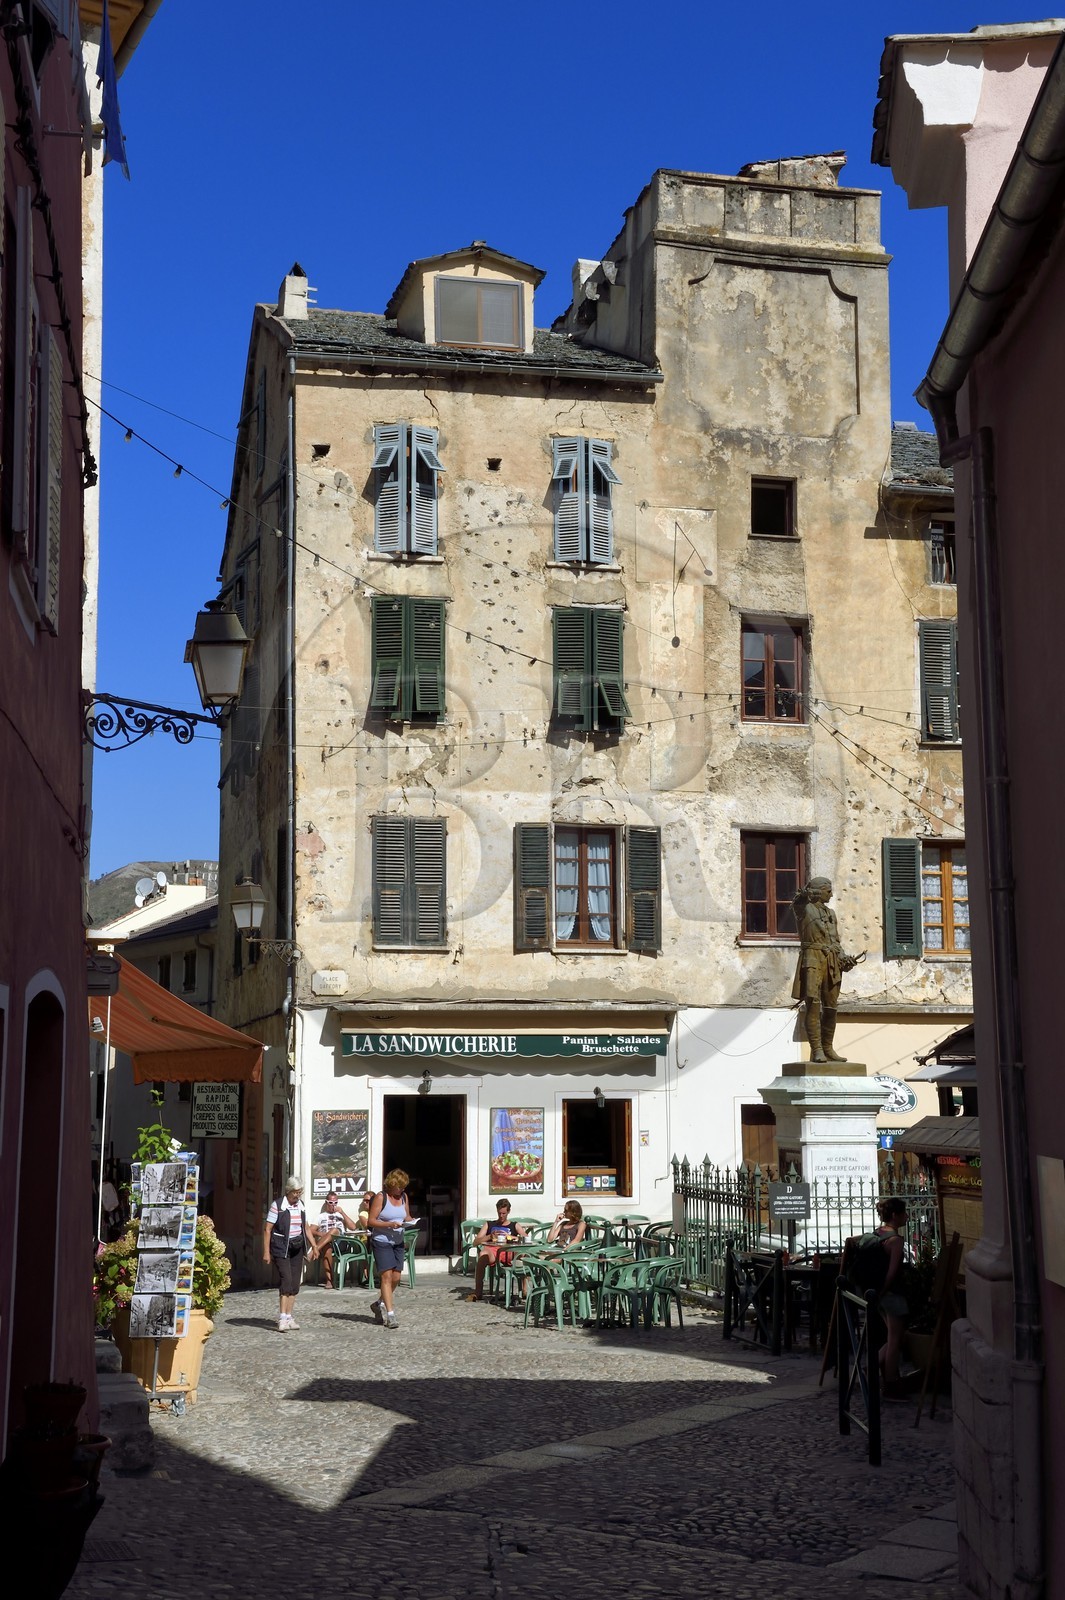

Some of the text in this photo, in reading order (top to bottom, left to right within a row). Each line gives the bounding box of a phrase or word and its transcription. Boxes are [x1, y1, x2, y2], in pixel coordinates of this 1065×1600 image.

[351, 1035, 518, 1054] LA SANDWICHERIE
[562, 1036, 661, 1045] Panini Salades
[582, 1044, 640, 1053] Bruschette
[196, 1085, 238, 1094] RESTAURATION
[205, 1094, 230, 1103] RAPIDE
[196, 1103, 238, 1112] BOISSONS PAIN
[217, 1112, 238, 1121] GLACES
[192, 1121, 238, 1131] PRODUITS CORSES
[313, 1177, 366, 1192] BHV
[517, 1182, 543, 1190] BHV
[786, 1185, 793, 1194] D
